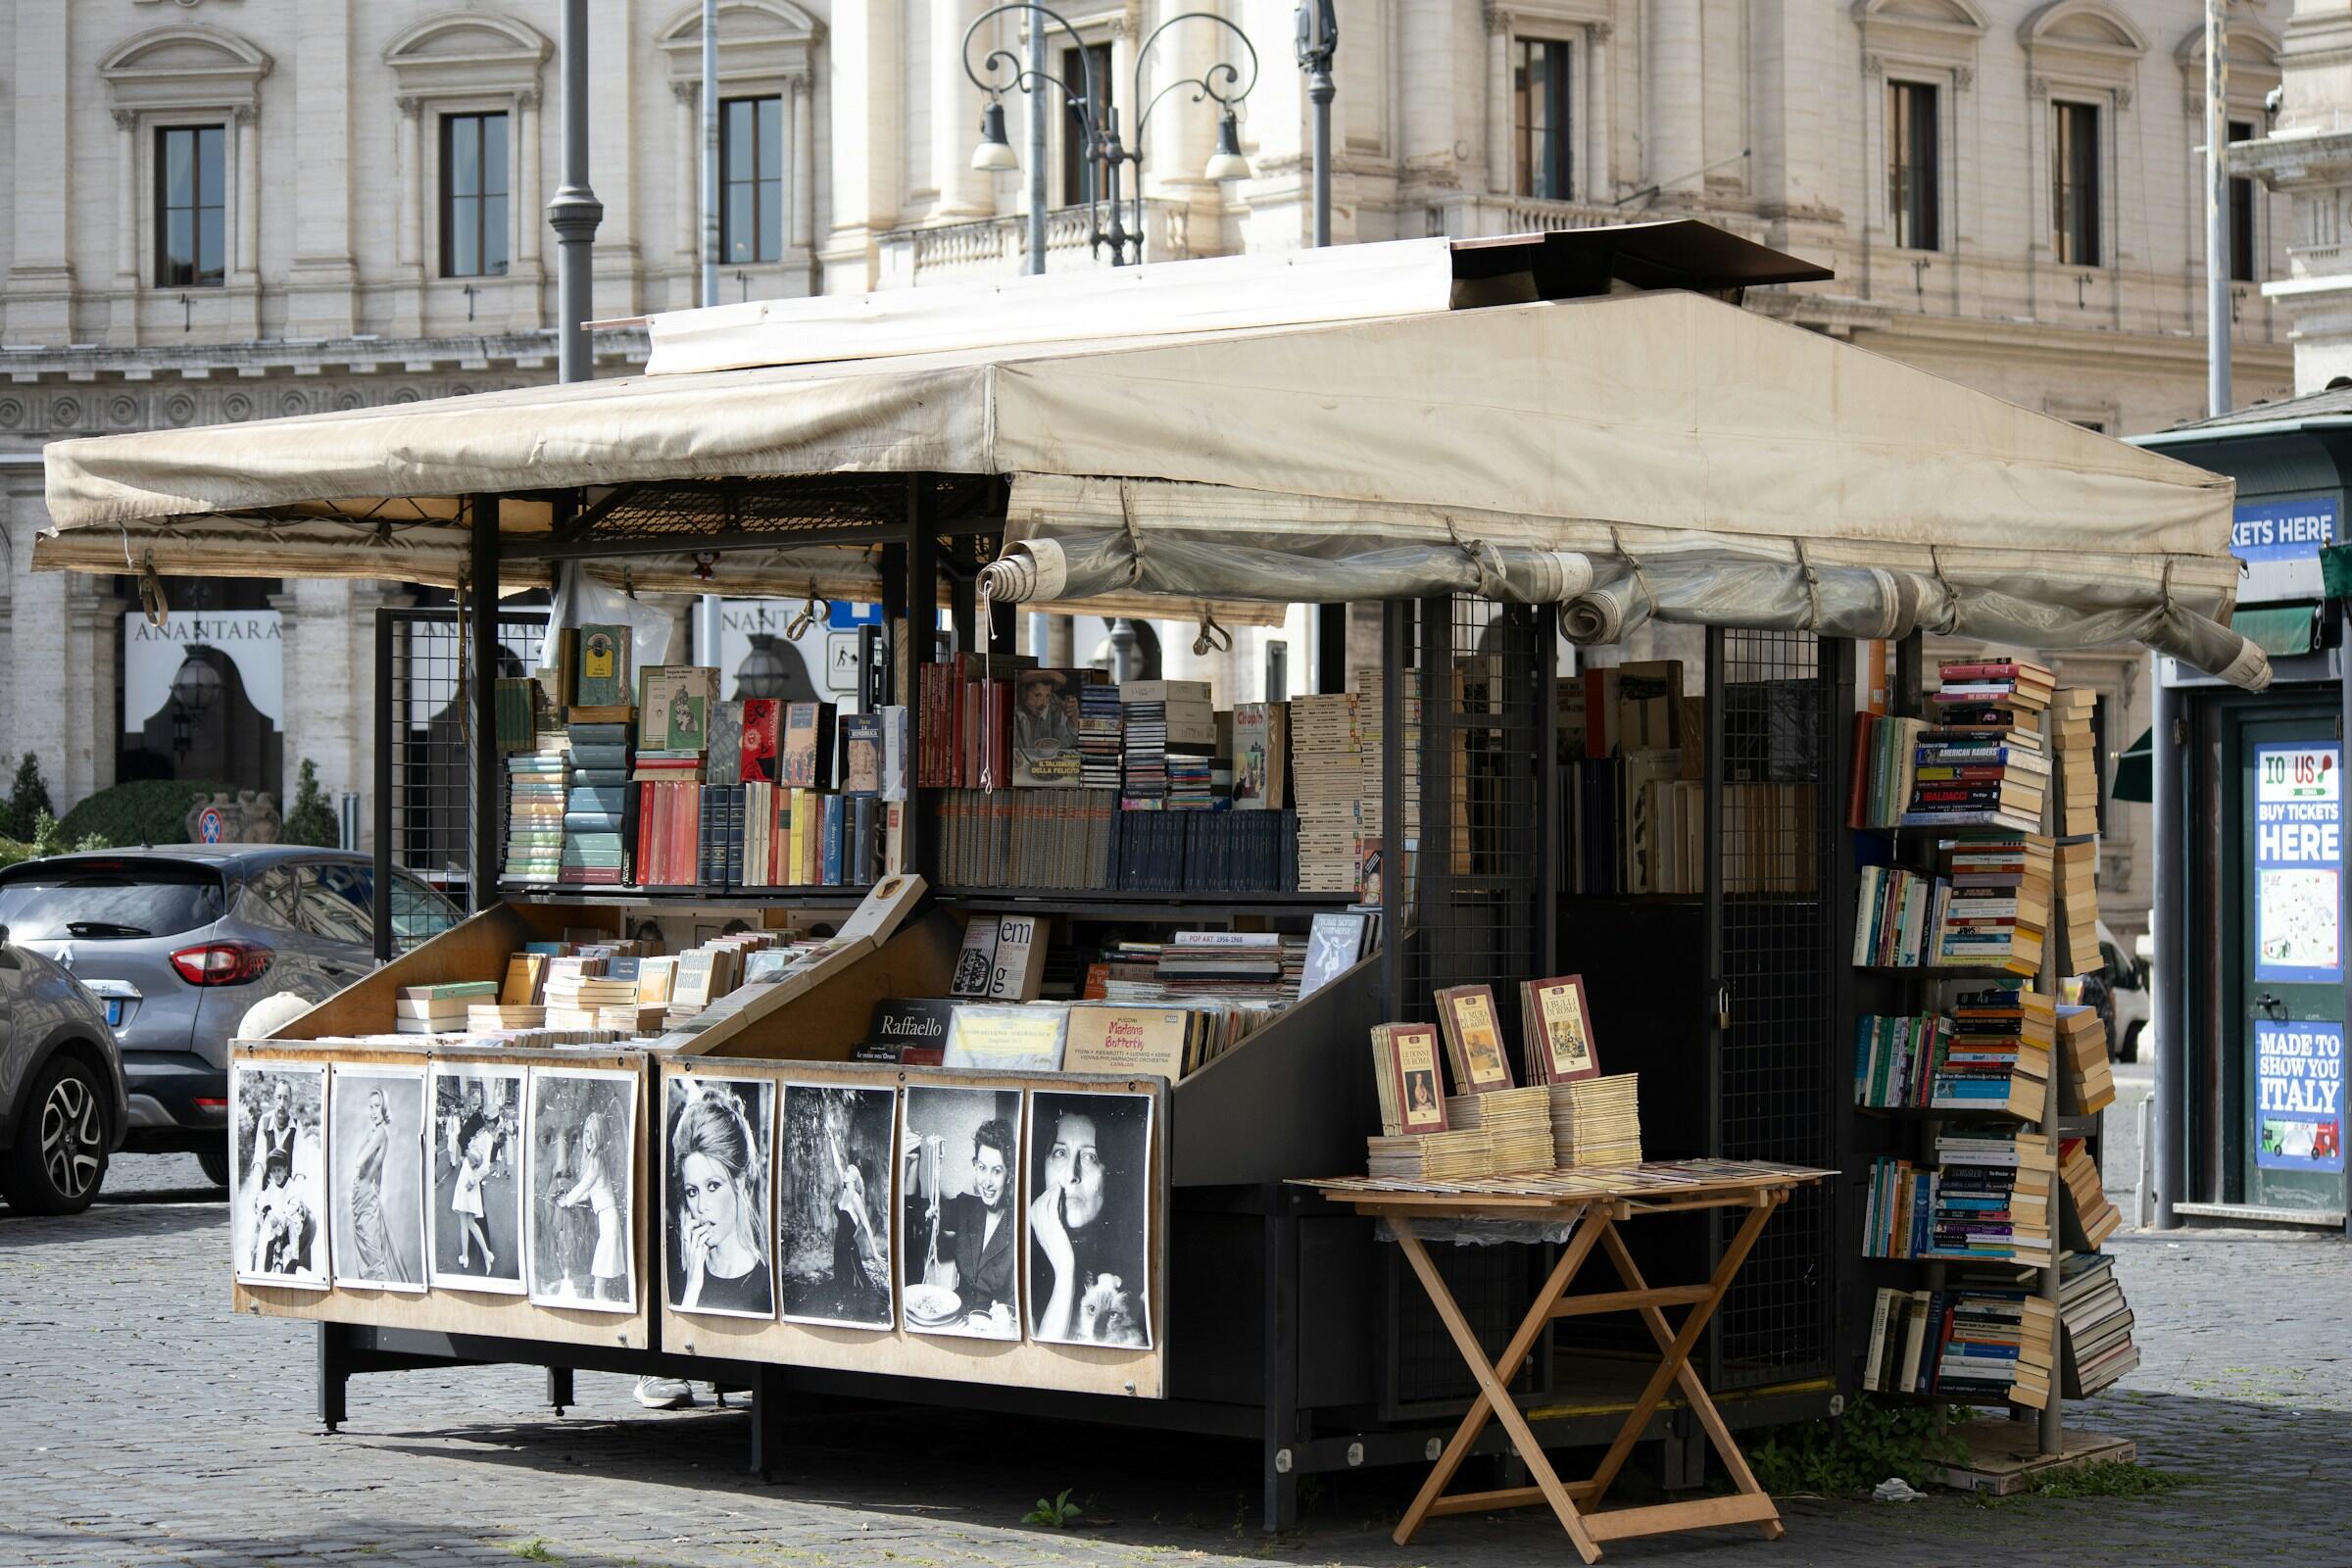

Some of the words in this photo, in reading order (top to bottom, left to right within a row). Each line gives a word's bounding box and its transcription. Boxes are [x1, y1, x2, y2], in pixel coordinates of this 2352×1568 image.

[2278, 514, 2332, 543] HERE
[135, 619, 282, 641] ANANTARA
[2259, 804, 2284, 821] BUY
[2287, 803, 2339, 821] TICKETS
[2259, 823, 2340, 861] HERE
[1001, 922, 1031, 944] em
[1556, 1005, 1578, 1015] ROMA
[880, 1015, 943, 1037] Raffaello
[1108, 1021, 1144, 1036] Madama
[1470, 1017, 1492, 1028] ROMA
[1104, 1036, 1145, 1052] Butterfly
[2259, 1032, 2313, 1057] MADE
[2316, 1035, 2340, 1057] TO
[1411, 1056, 1431, 1065] ROMA
[2259, 1055, 2306, 1077] SHOW
[2307, 1057, 2340, 1079] YOU
[2259, 1077, 2340, 1114] ITALY
